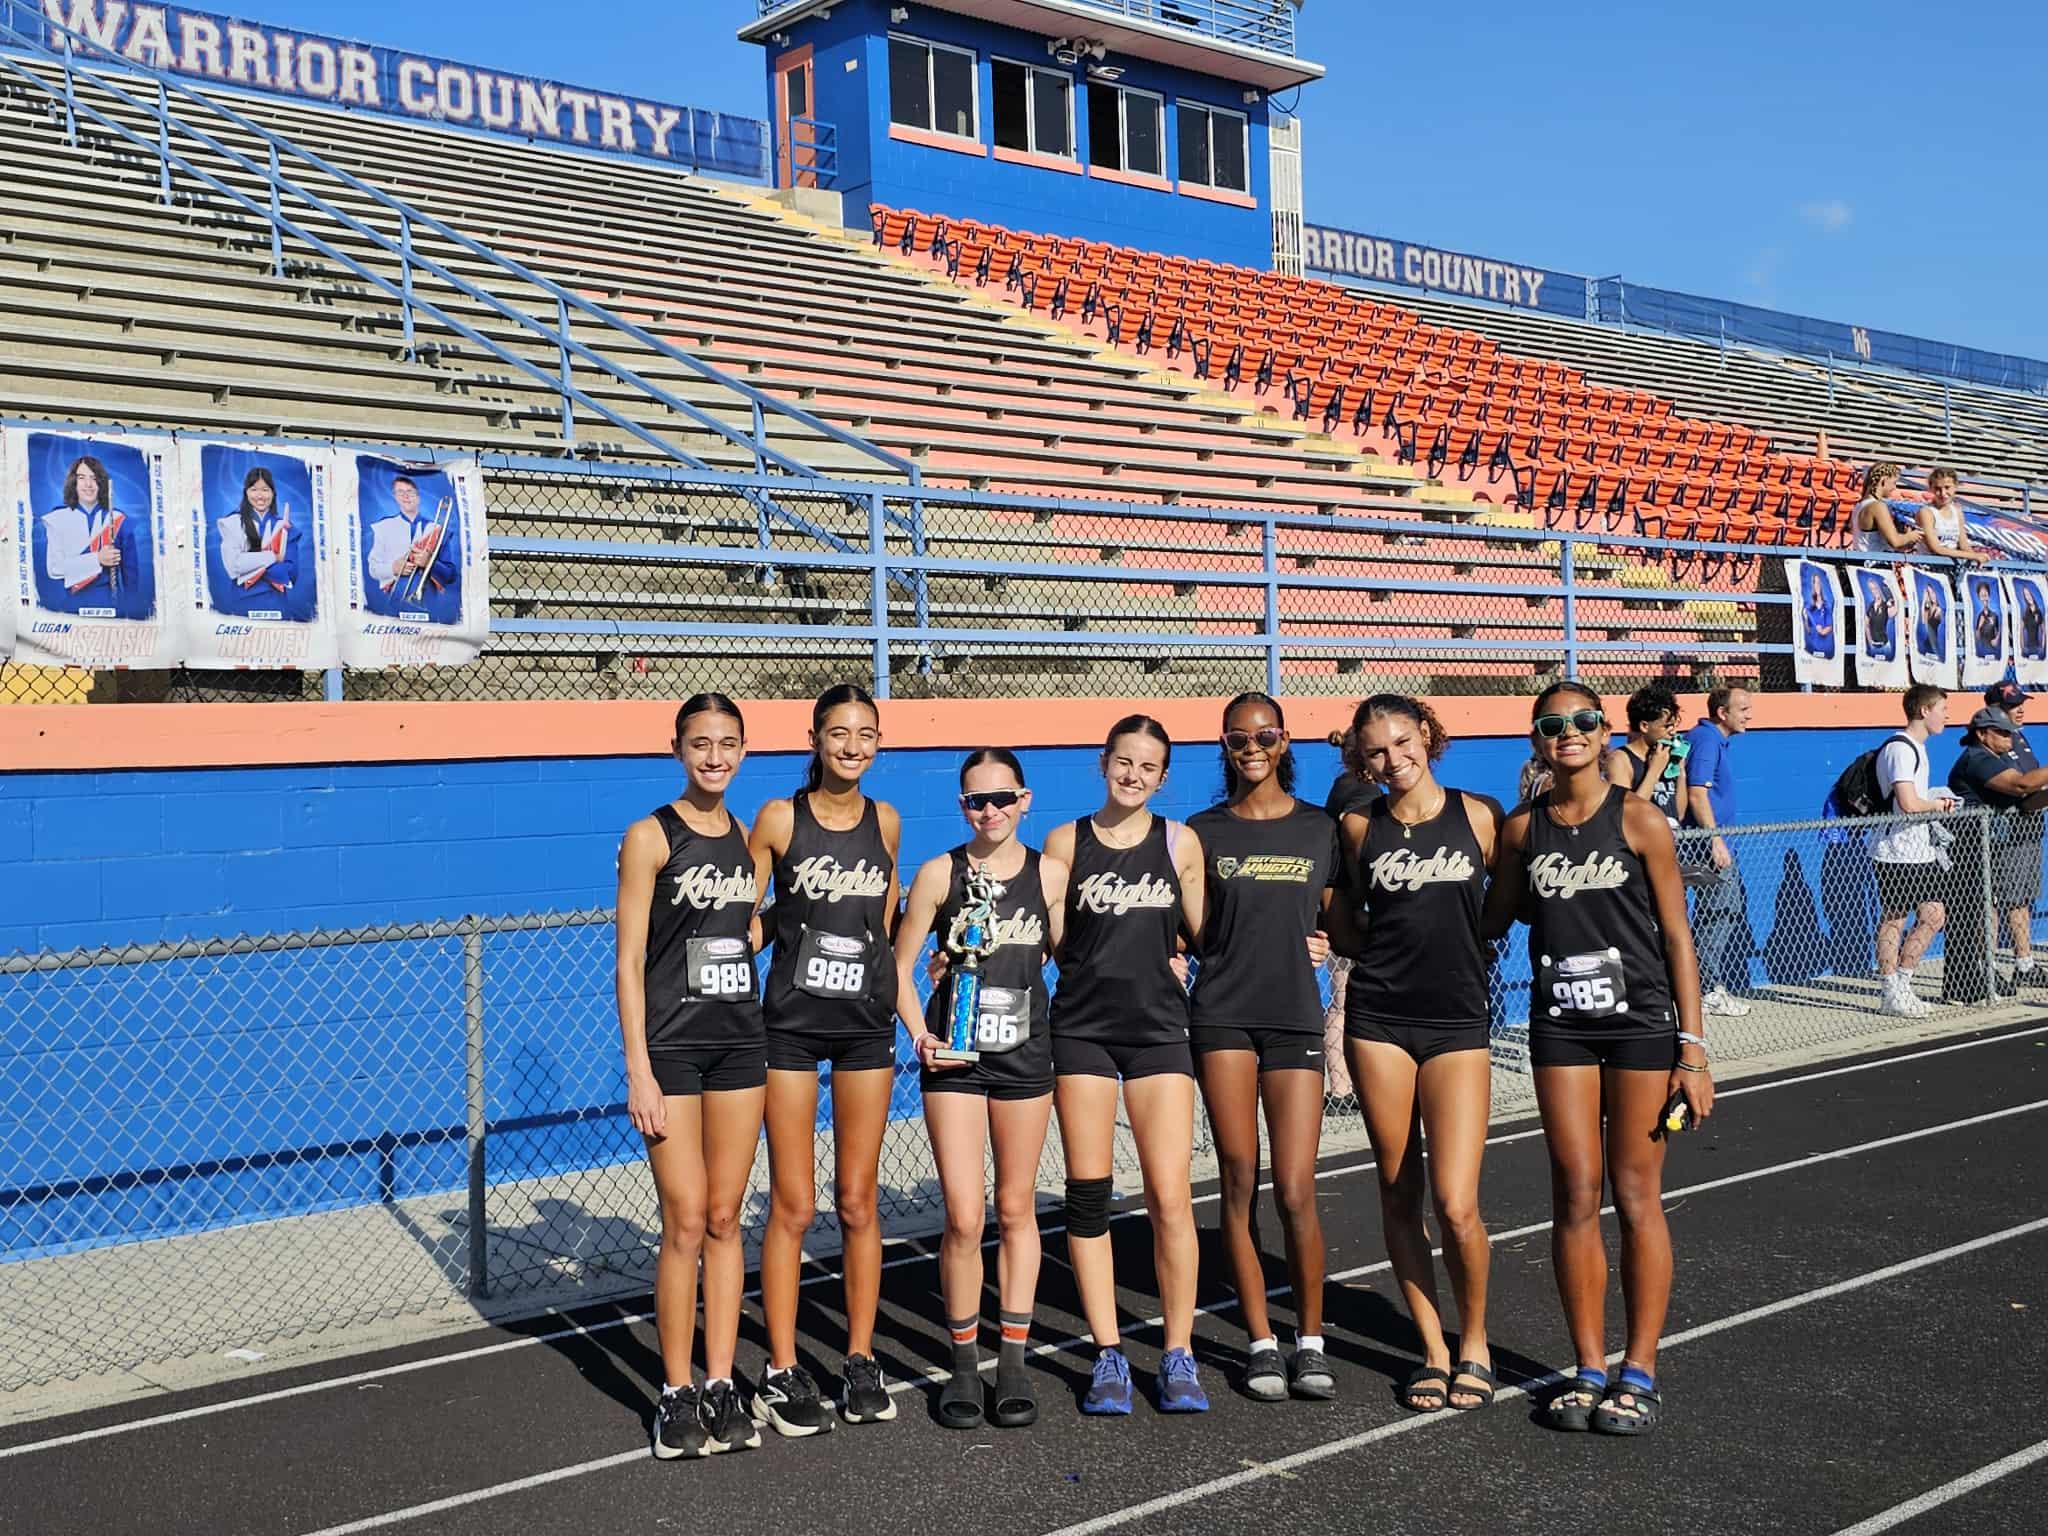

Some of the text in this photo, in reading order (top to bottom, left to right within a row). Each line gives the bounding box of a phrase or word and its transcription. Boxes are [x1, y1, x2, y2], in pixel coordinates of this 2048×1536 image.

[46, 0, 680, 156] WARRIOR COUNTRY
[1303, 226, 1544, 307] RRIOR COUNTRY
[32, 620, 72, 633] LOGAN
[216, 624, 254, 635] CARLY
[363, 623, 421, 635] ALEXANDER
[789, 856, 888, 903] Knights
[1369, 846, 1475, 892] Knights
[1527, 850, 1630, 899] Knights
[1076, 872, 1176, 915] Knights
[701, 962, 750, 995] 989
[806, 957, 865, 992] 988
[1552, 977, 1614, 1010] 985
[978, 1013, 1018, 1044] 86
